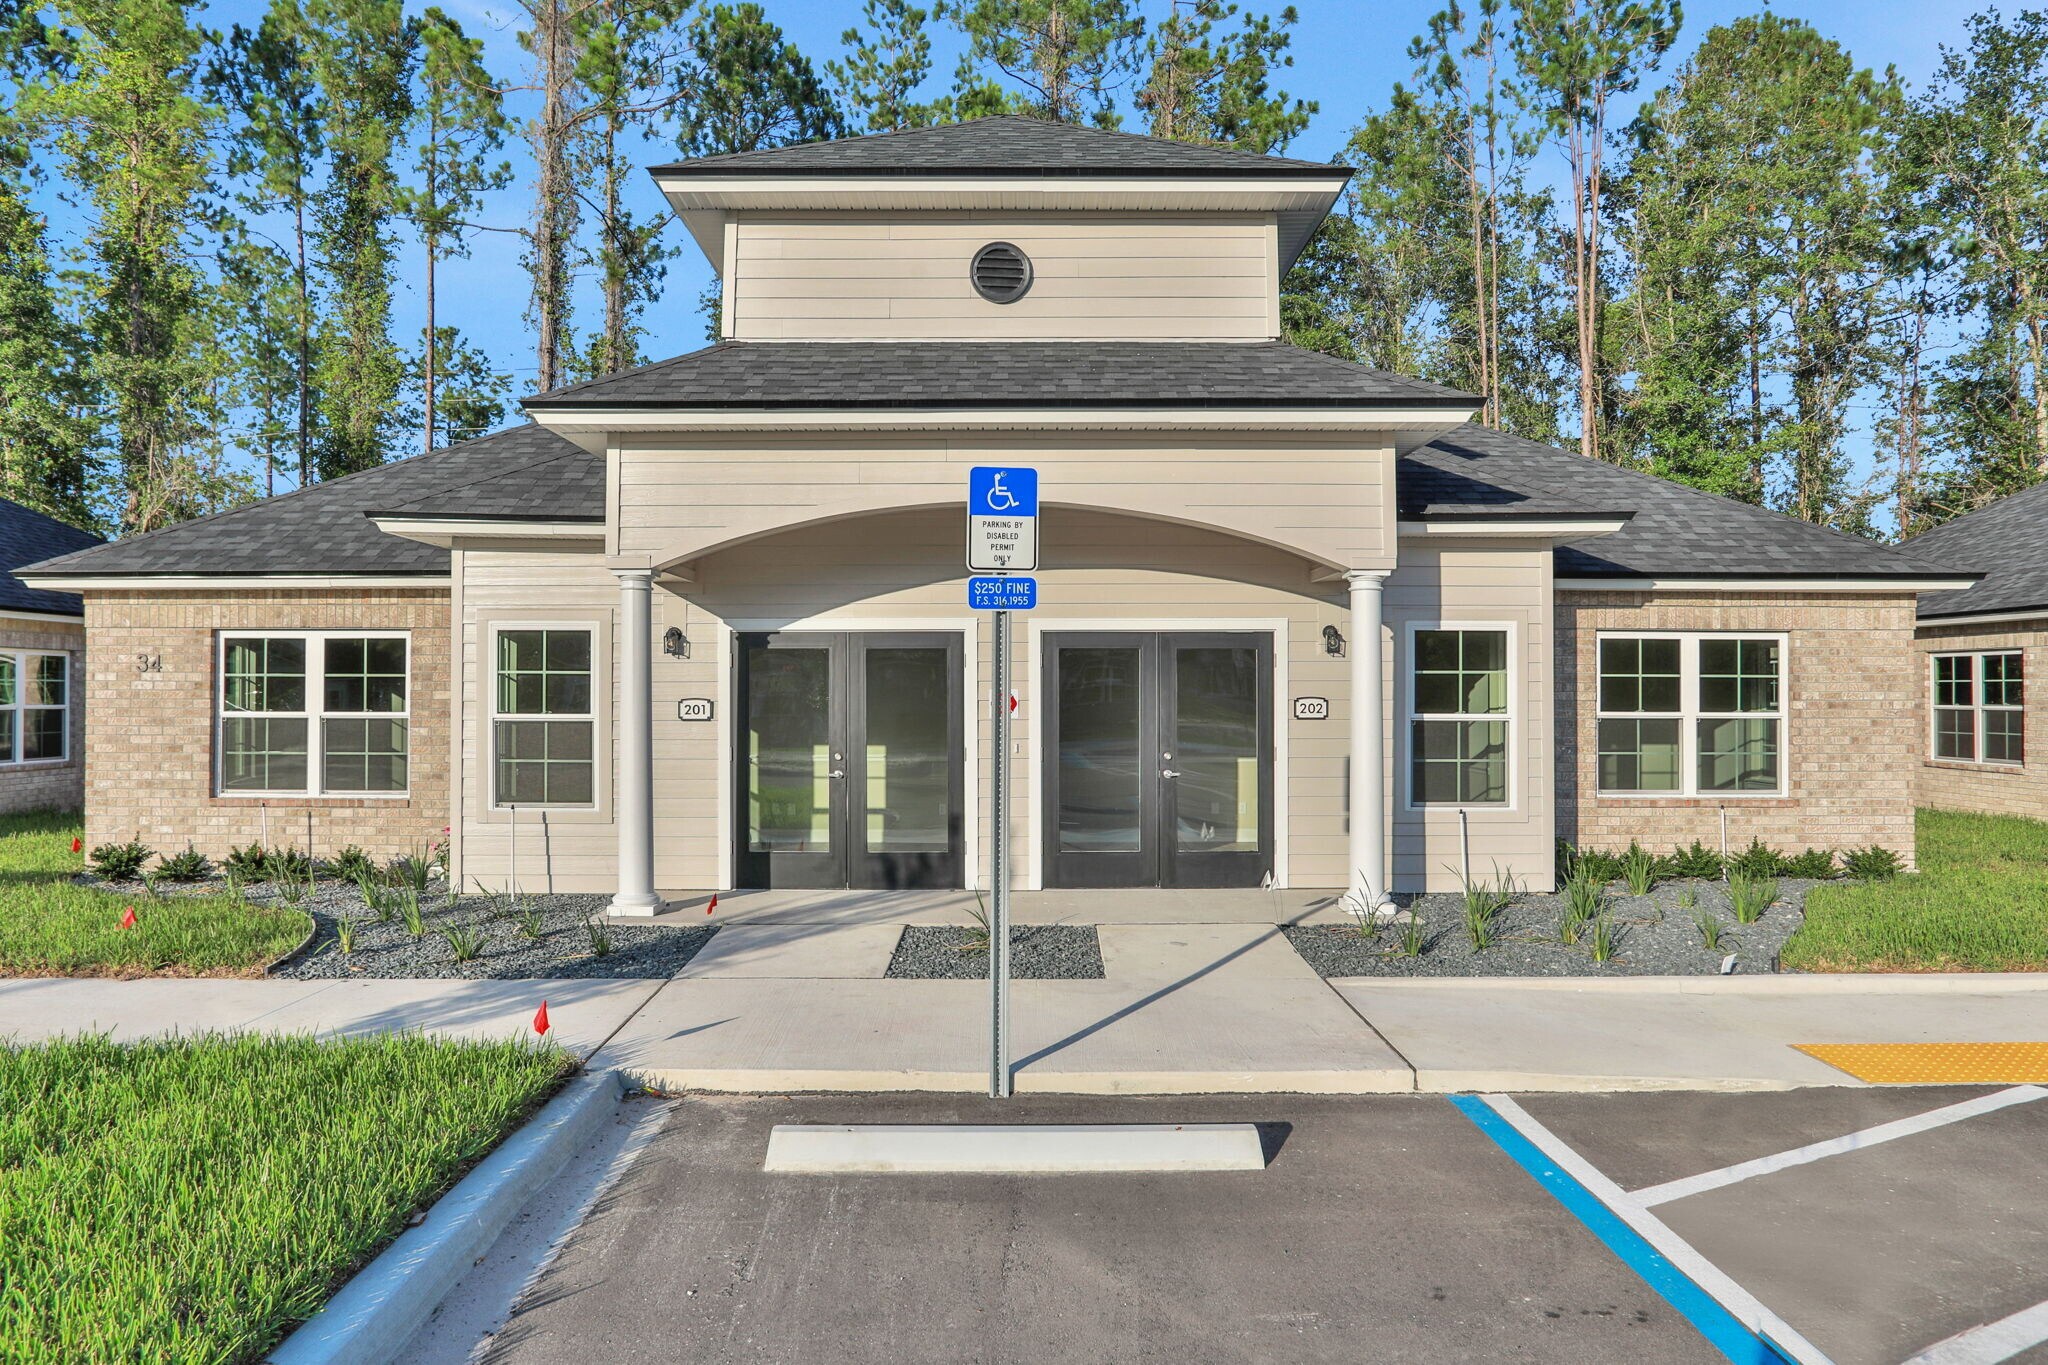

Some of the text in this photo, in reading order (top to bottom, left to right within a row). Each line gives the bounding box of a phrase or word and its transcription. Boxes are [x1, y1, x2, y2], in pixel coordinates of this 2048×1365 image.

[982, 520, 1024, 529] PARKING BY
[986, 532, 1019, 540] DISABLED
[974, 581, 1030, 595] $250 FINE
[976, 596, 1029, 605] F.S. 316.1955
[136, 653, 163, 672] 34
[684, 704, 706, 715] 201
[1300, 703, 1323, 713] 202
